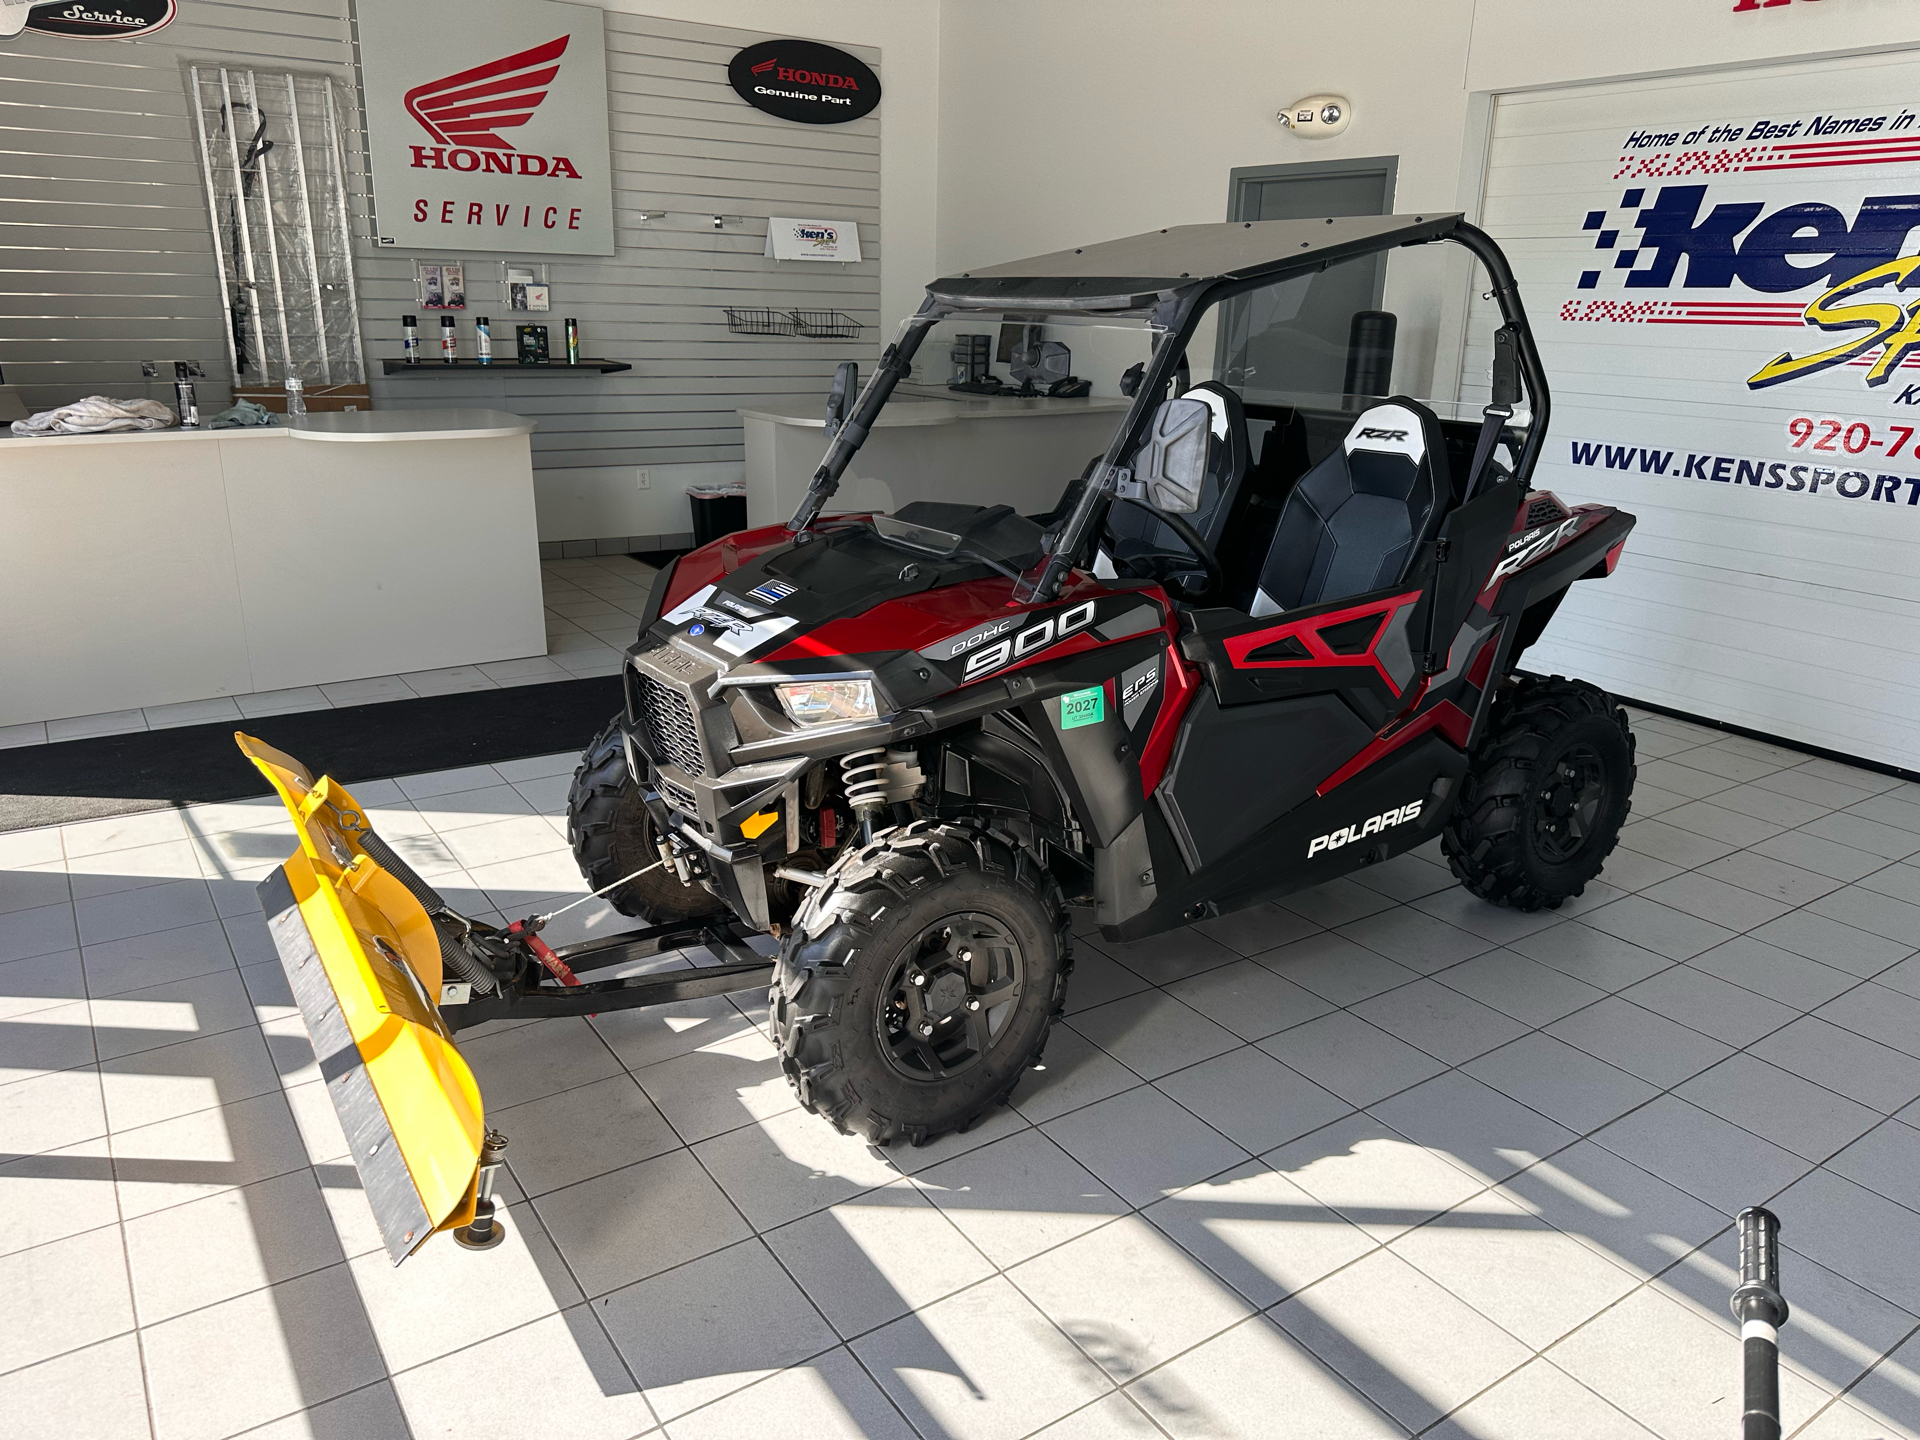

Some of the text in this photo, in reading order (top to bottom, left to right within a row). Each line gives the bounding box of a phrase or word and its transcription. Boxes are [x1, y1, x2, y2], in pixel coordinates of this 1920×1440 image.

[63, 4, 148, 26] Service
[776, 66, 860, 91] HONDA
[753, 86, 852, 106] Genuine Part
[1623, 109, 1917, 150] Home of the Best Names in
[408, 145, 583, 180] HONDA
[413, 198, 582, 231] SERVICE
[1355, 427, 1409, 442] RZR
[1789, 417, 1920, 461] 920-7
[1483, 516, 1580, 593] RZR
[1508, 527, 1540, 553] POLARIS
[678, 606, 754, 637] RZR
[722, 599, 750, 614] POLARIS
[950, 620, 1011, 656] DOHC
[963, 600, 1096, 683] 900
[1122, 667, 1157, 700] EPS
[1066, 697, 1099, 715] 2027
[1307, 799, 1424, 859] POLARIS
[544, 951, 569, 979] WARN
